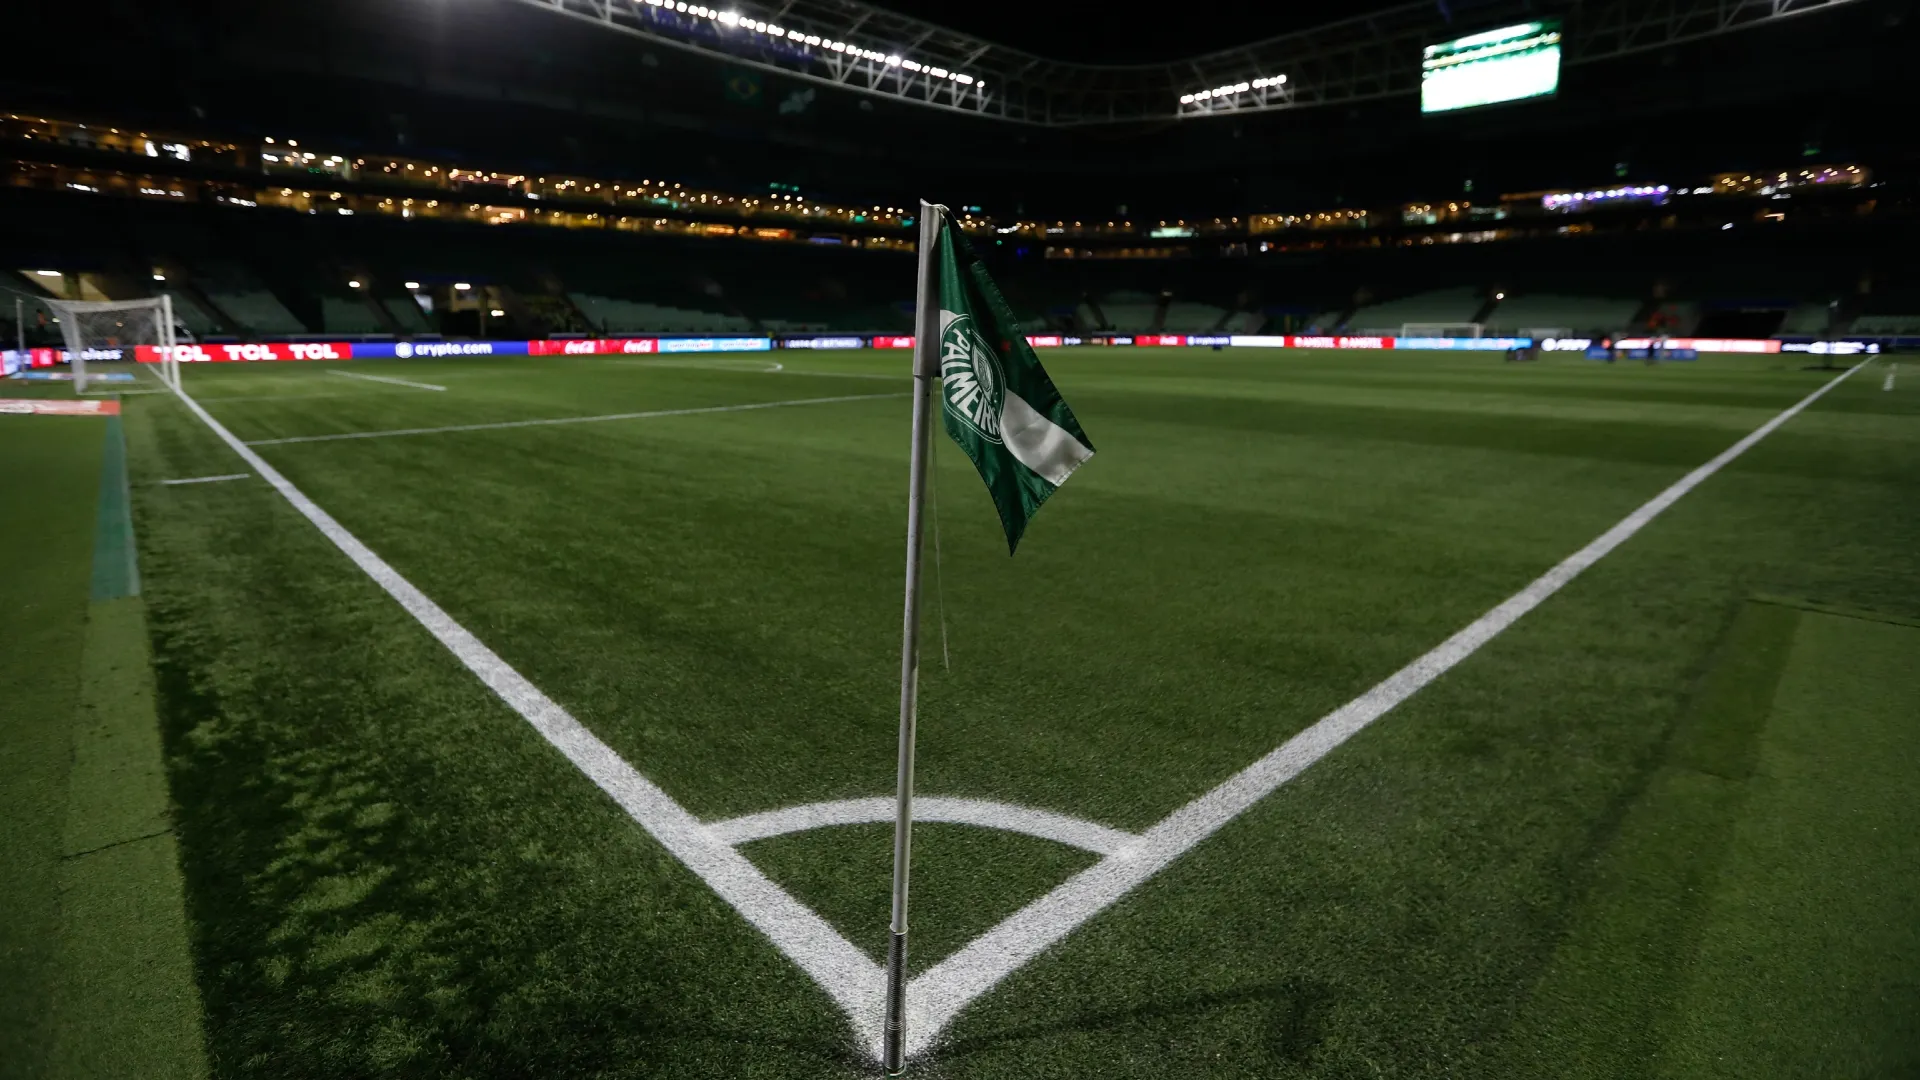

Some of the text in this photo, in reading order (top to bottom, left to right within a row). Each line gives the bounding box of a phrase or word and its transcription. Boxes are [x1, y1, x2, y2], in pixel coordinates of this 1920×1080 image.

[152, 345, 211, 362] TCL
[223, 344, 277, 361] TCL
[288, 343, 339, 360] TCL
[415, 342, 493, 357] crypto.com
[941, 328, 1000, 435] PALMEIRA
